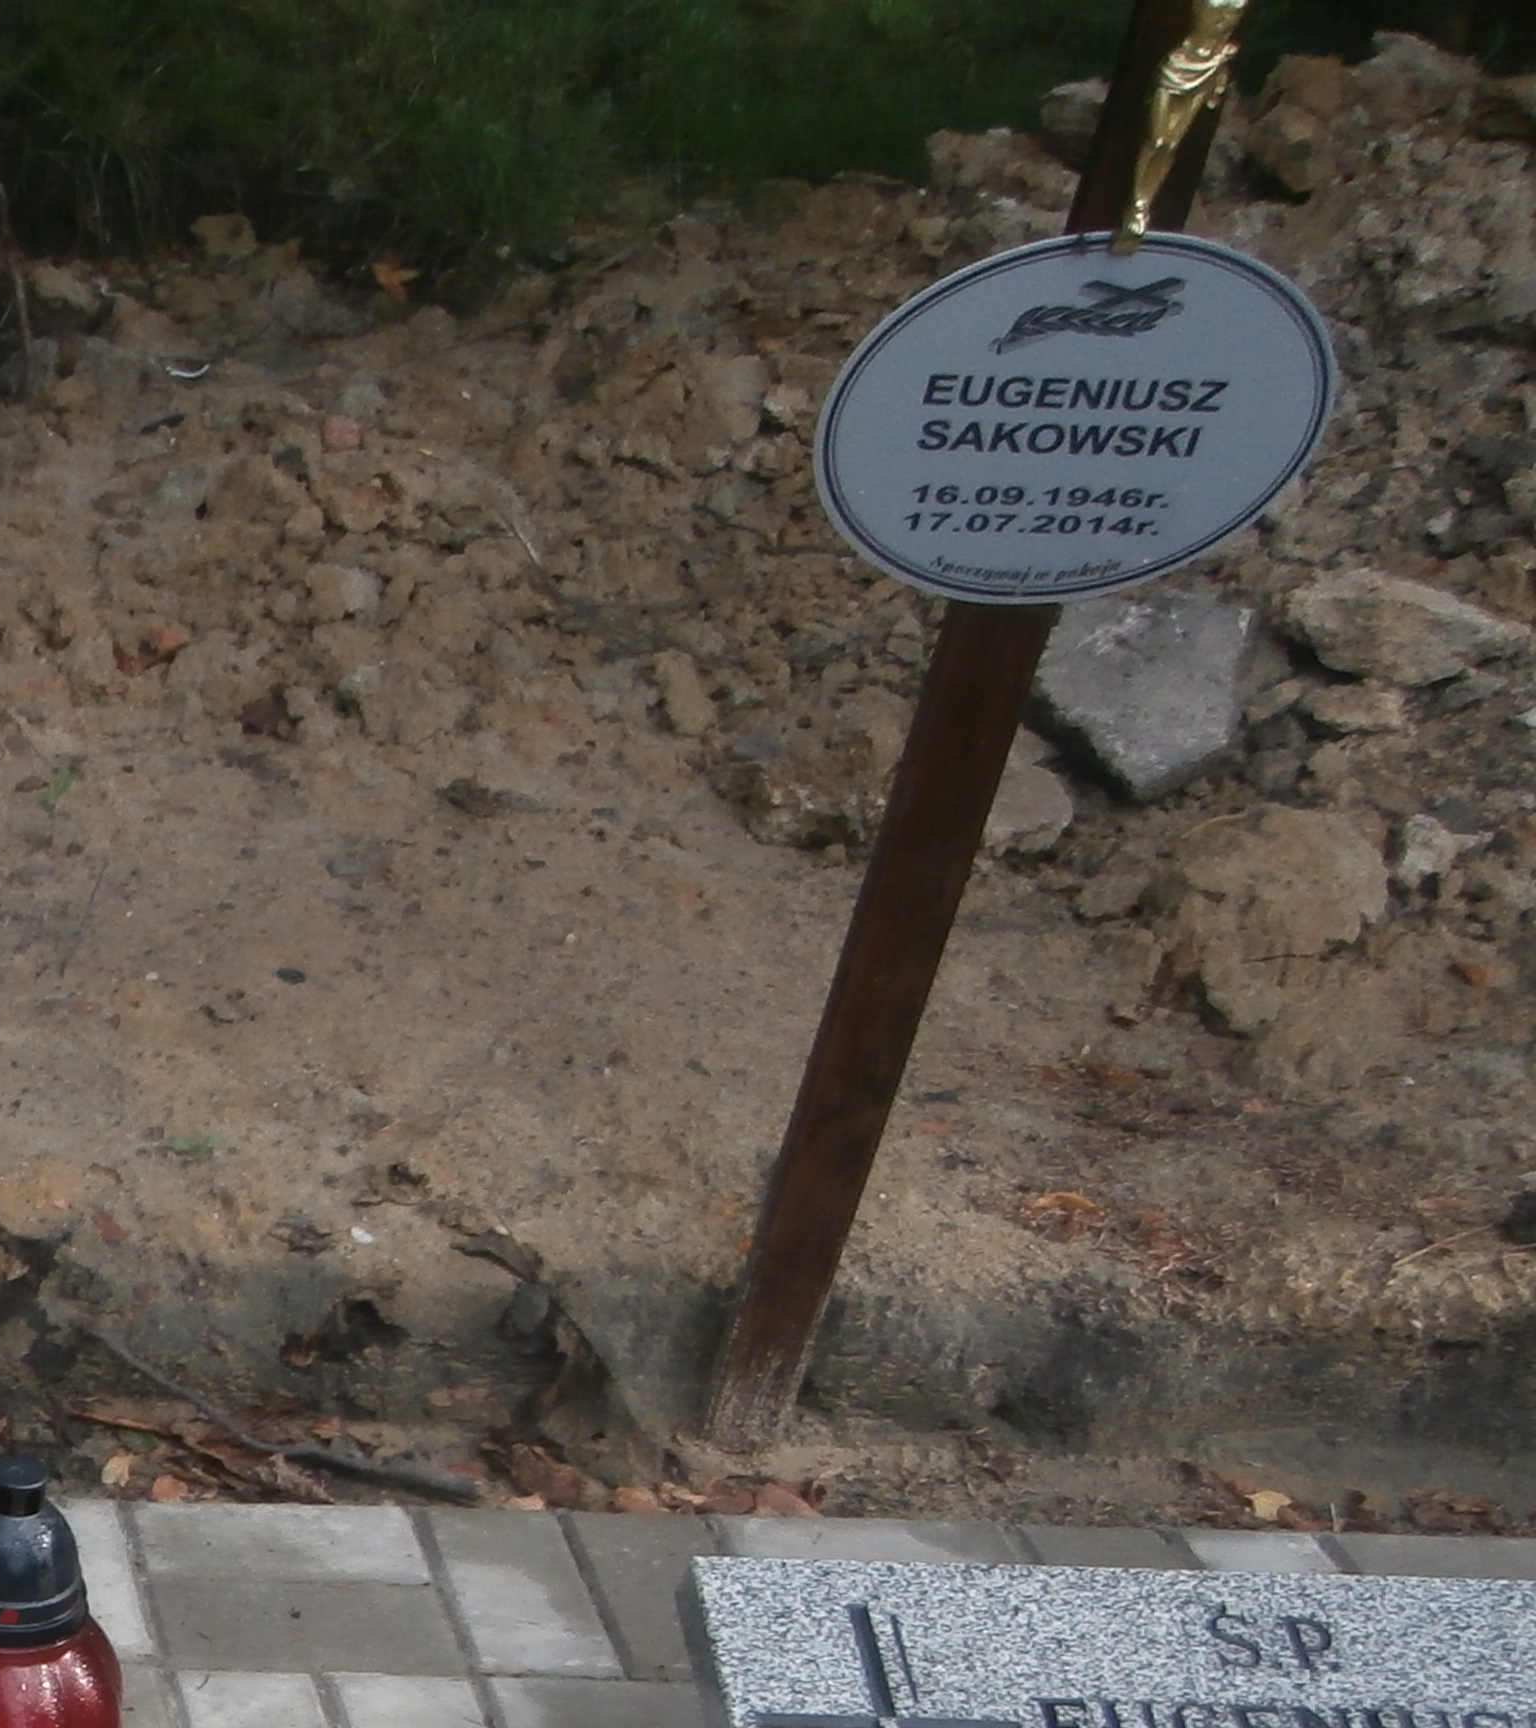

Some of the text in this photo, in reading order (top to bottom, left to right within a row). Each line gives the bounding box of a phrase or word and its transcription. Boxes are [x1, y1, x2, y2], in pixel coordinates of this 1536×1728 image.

[922, 373, 1229, 413] EUGENIUSZ
[916, 420, 1203, 458] SAKOWSKI
[911, 484, 1170, 509] 16.09.1946r.
[903, 512, 1160, 536] 17.07.2014r.
